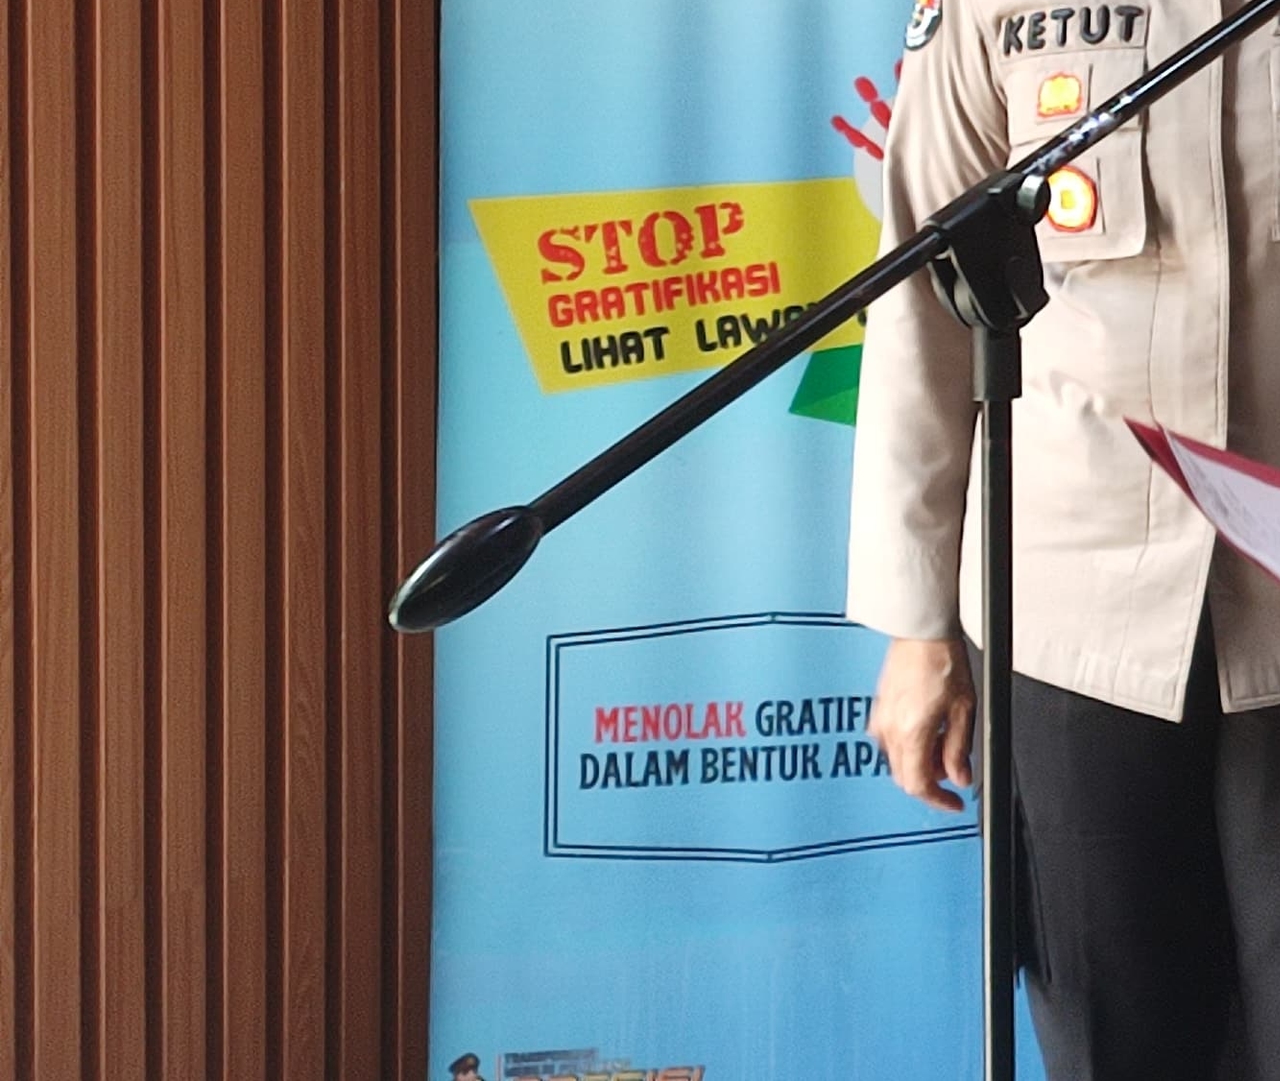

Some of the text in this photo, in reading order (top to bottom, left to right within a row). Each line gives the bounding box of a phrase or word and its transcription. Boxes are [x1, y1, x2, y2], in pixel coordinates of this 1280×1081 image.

[1003, 4, 1144, 57] KETUT
[537, 201, 745, 284] STOP
[548, 262, 781, 328] GRATIFIKASI
[560, 326, 670, 374] LIHAT
[695, 302, 818, 352] LAWA
[594, 701, 747, 744] MENOLAK
[579, 747, 690, 789] DALAM
[700, 742, 823, 785] BENTUK
